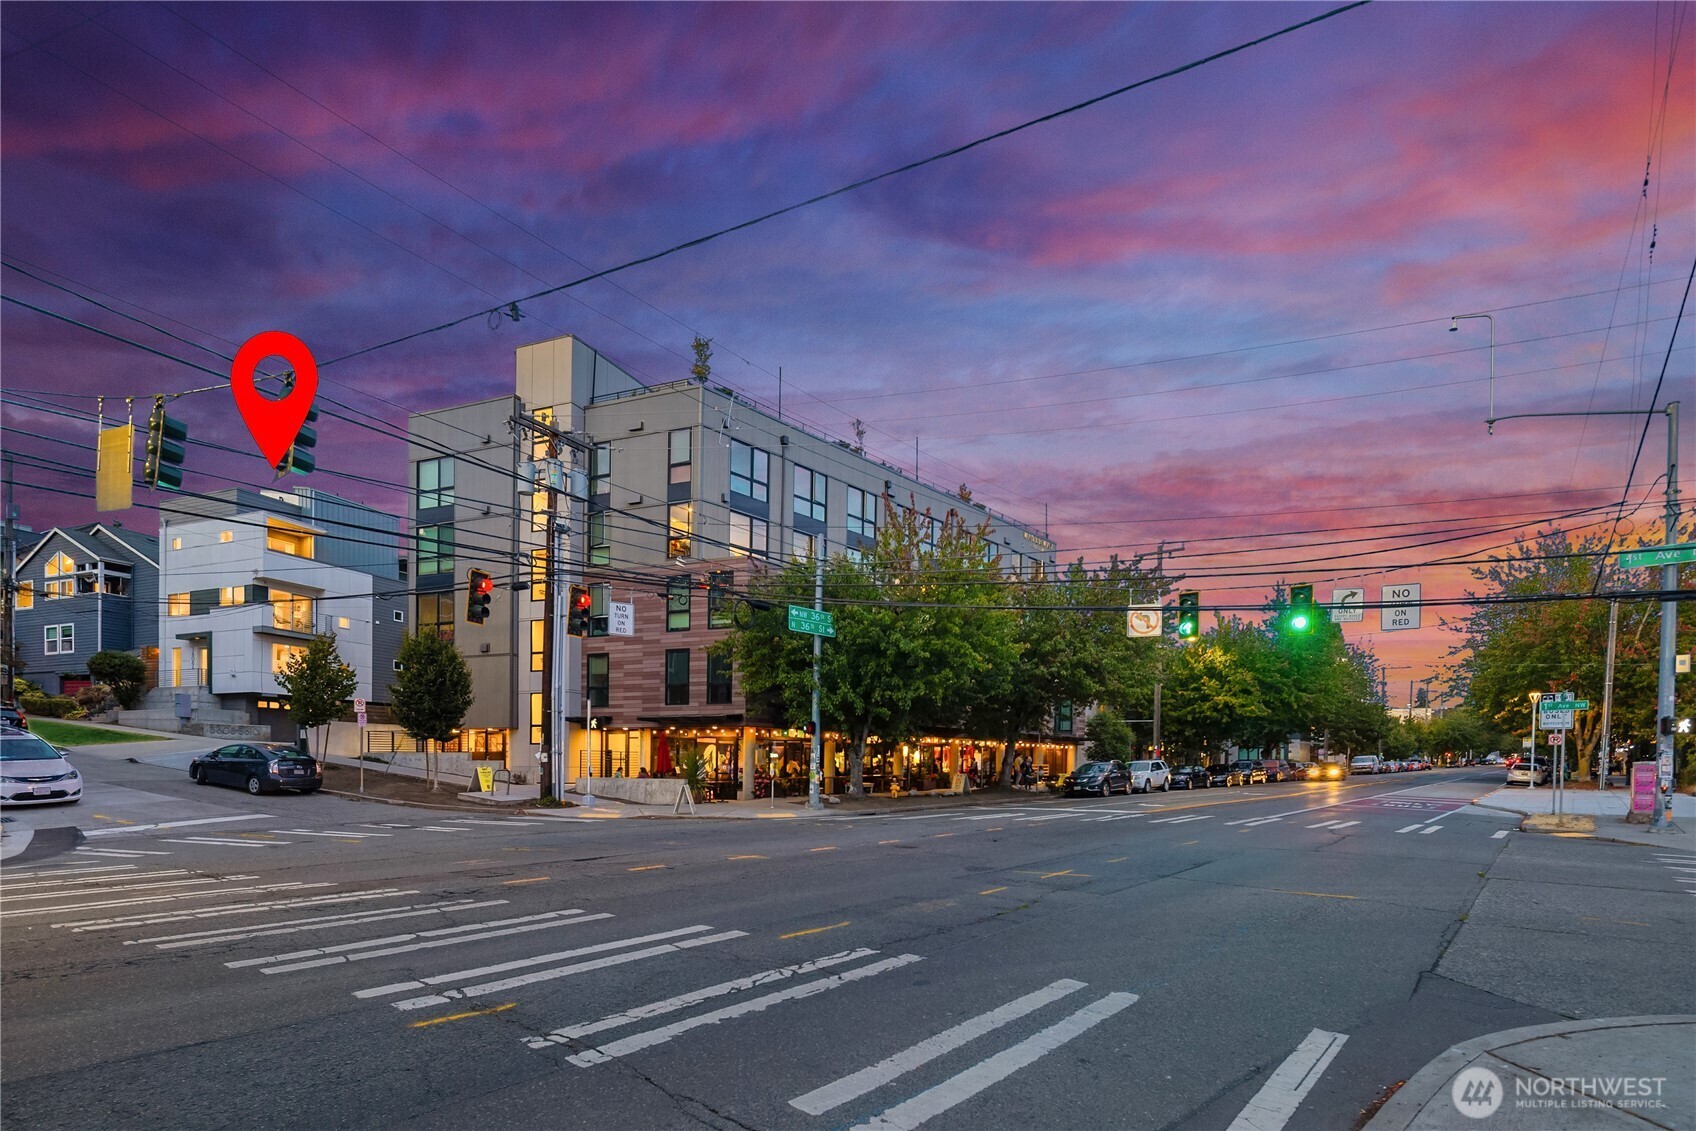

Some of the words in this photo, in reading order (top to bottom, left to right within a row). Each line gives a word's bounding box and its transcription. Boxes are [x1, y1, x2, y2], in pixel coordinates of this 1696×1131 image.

[1626, 554, 1642, 564] 1st
[1655, 551, 1681, 560] Ave
[1392, 589, 1411, 599] NO
[1392, 618, 1410, 626] RED
[818, 625, 825, 633] St
